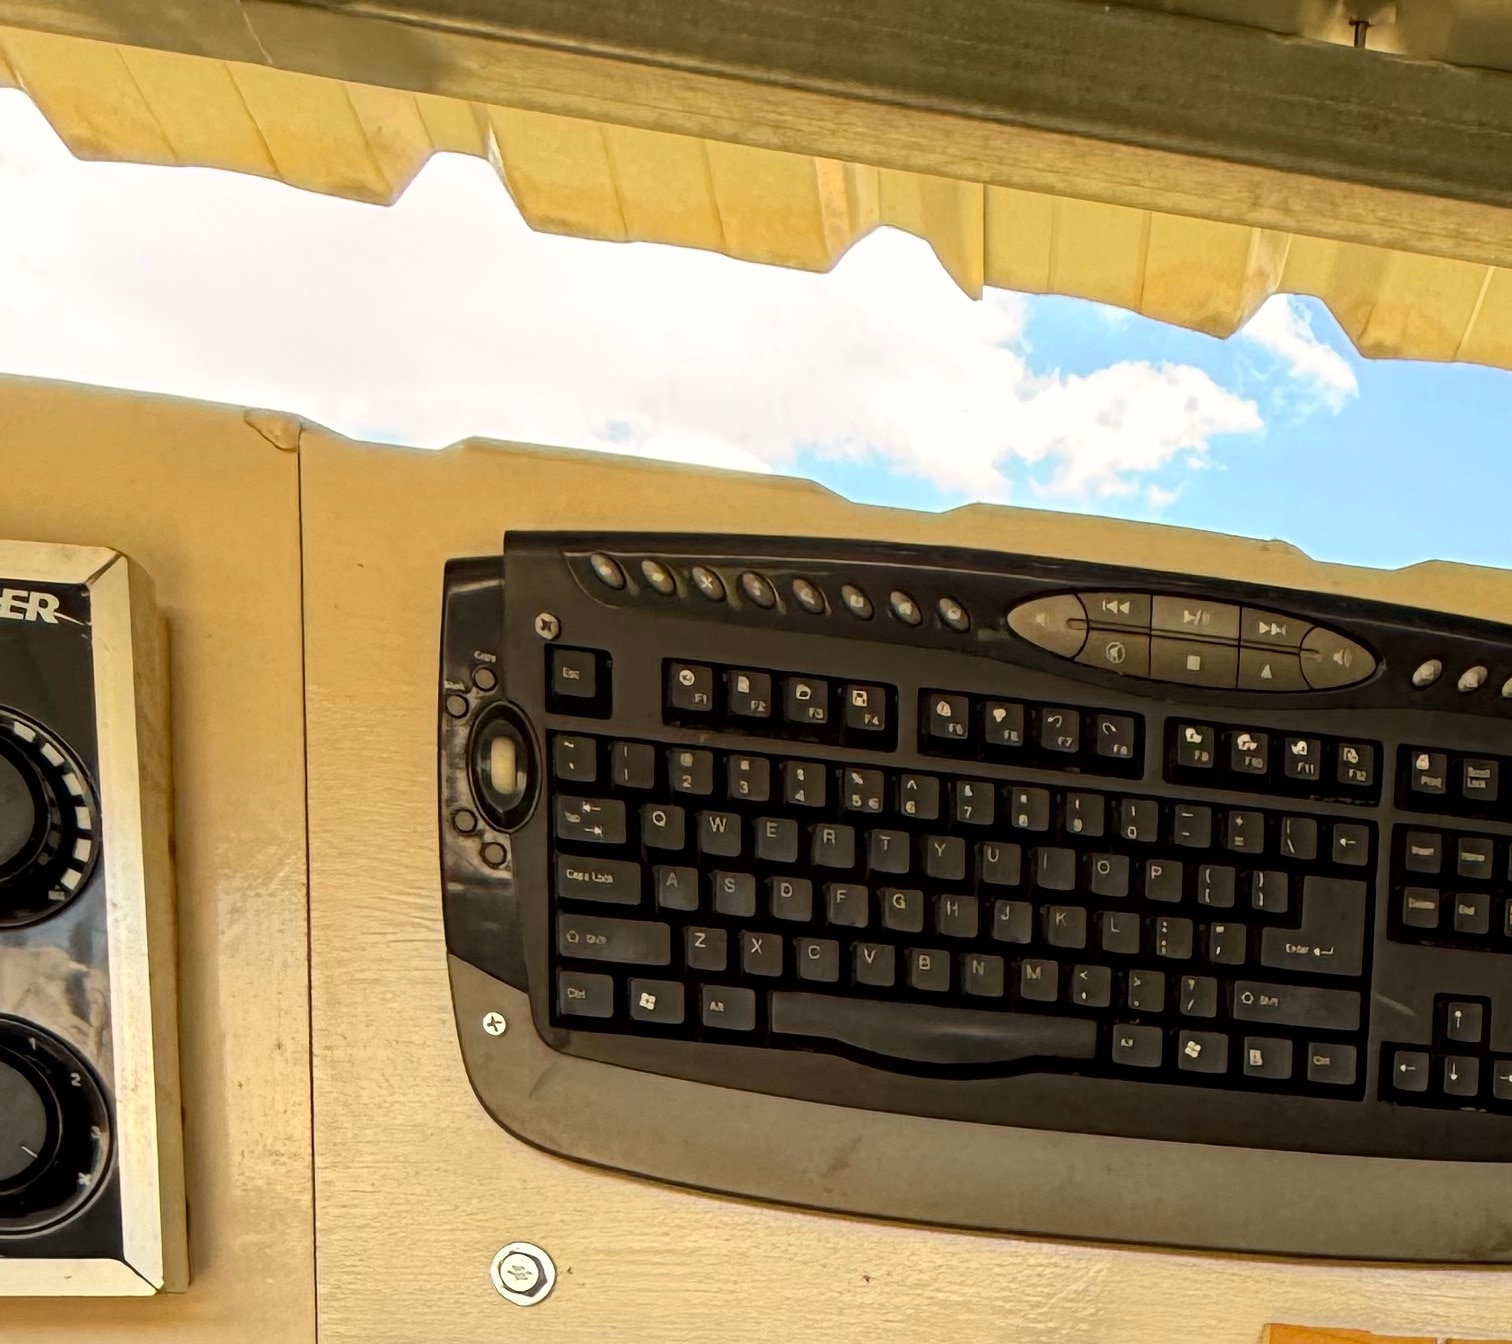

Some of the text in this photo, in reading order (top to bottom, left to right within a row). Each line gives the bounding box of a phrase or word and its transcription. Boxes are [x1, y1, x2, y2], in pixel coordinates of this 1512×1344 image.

[694, 693, 707, 705] F1
[864, 713, 880, 725] F4
[652, 810, 667, 827] Q
[709, 816, 727, 833] W
[766, 821, 778, 838] E
[823, 828, 836, 845] R
[879, 835, 891, 851] T
[934, 842, 946, 857] Y
[987, 846, 1000, 863] U
[1097, 860, 1111, 875] O
[1150, 865, 1162, 880] P
[665, 872, 679, 888] A
[724, 877, 736, 893] S
[780, 882, 793, 898] D
[836, 889, 847, 903] F
[892, 893, 906, 909] G
[946, 900, 959, 917] H
[1000, 905, 1010, 921] J
[1055, 912, 1067, 925] K
[1110, 917, 1120, 933] L
[694, 932, 706, 948] Z
[750, 938, 762, 954] X
[807, 945, 821, 960] C
[863, 948, 876, 964] V
[918, 954, 931, 970] B
[972, 959, 985, 976] N
[1026, 964, 1041, 980] M
[70, 1072, 81, 1087] 2
